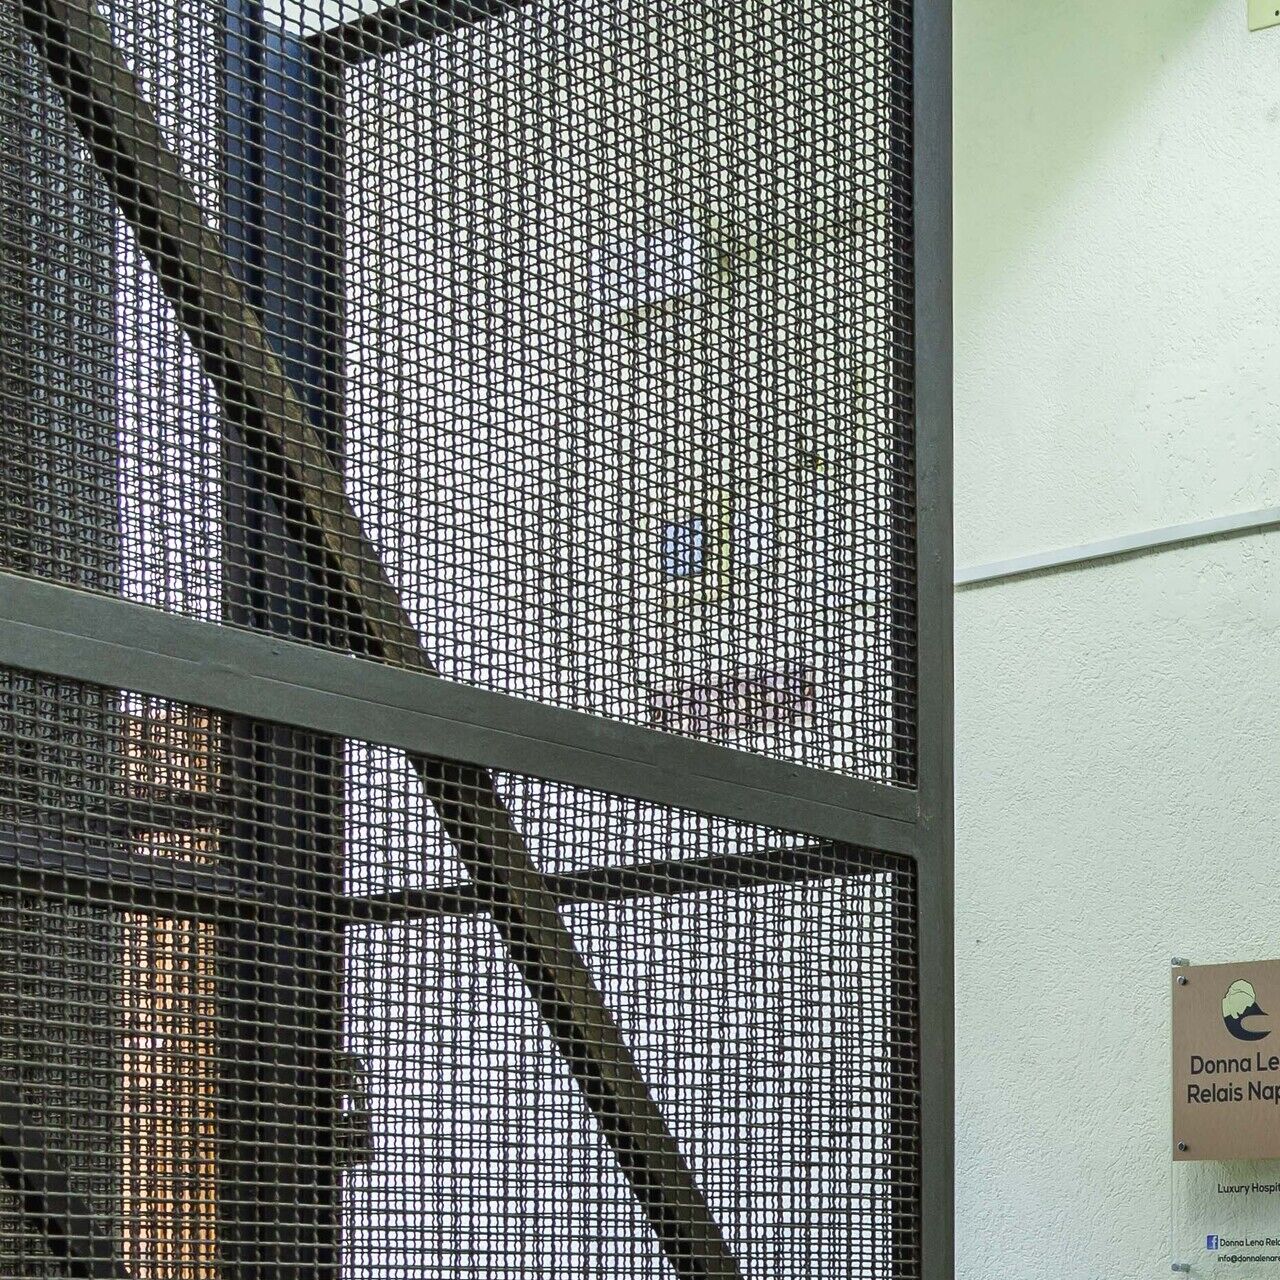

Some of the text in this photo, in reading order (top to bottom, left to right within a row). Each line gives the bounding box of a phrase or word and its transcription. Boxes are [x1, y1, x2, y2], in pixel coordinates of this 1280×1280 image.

[1190, 1055, 1252, 1075] Donna
[1187, 1082, 1244, 1104] Relais
[1217, 1183, 1250, 1195] Luxury
[1219, 1238, 1244, 1247] Donna
[1245, 1238, 1264, 1247] Lena
